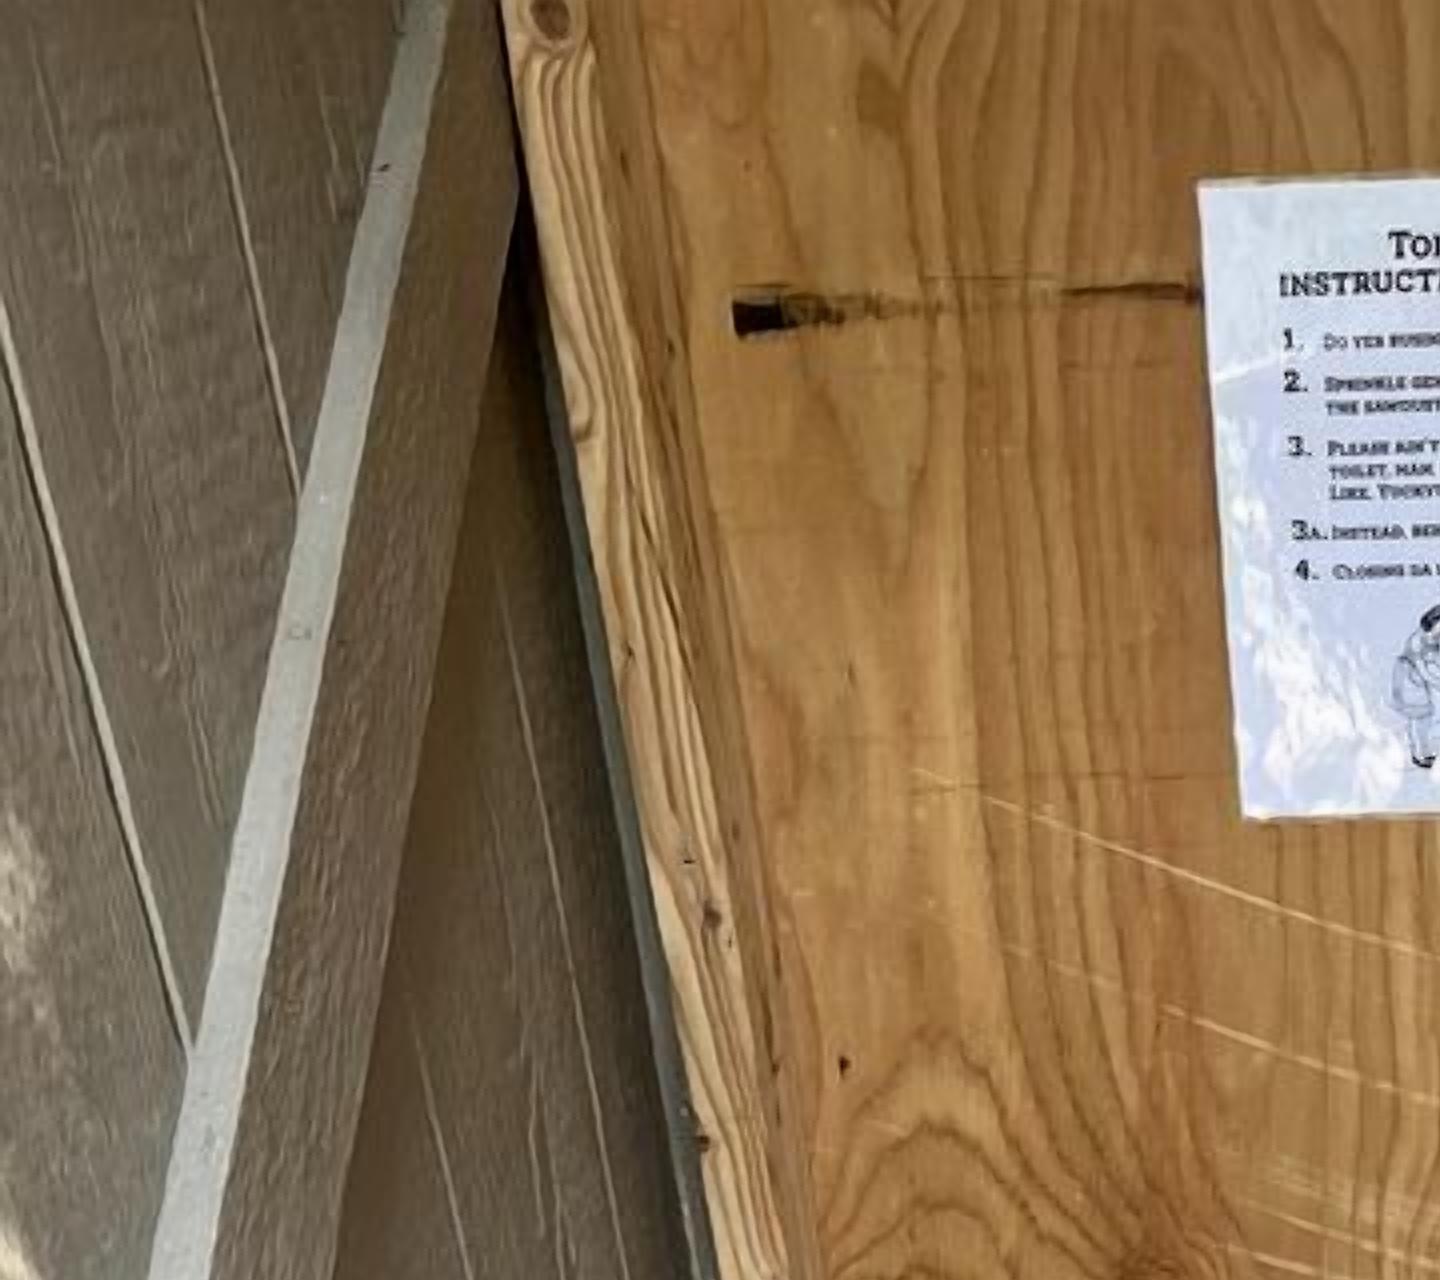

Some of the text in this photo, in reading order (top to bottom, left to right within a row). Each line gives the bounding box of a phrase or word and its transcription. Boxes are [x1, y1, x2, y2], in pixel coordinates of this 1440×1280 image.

[1283, 328, 1304, 351] 1.
[1283, 368, 1309, 393] 2.
[1288, 435, 1313, 456] 3.
[1295, 559, 1320, 581] 4.
